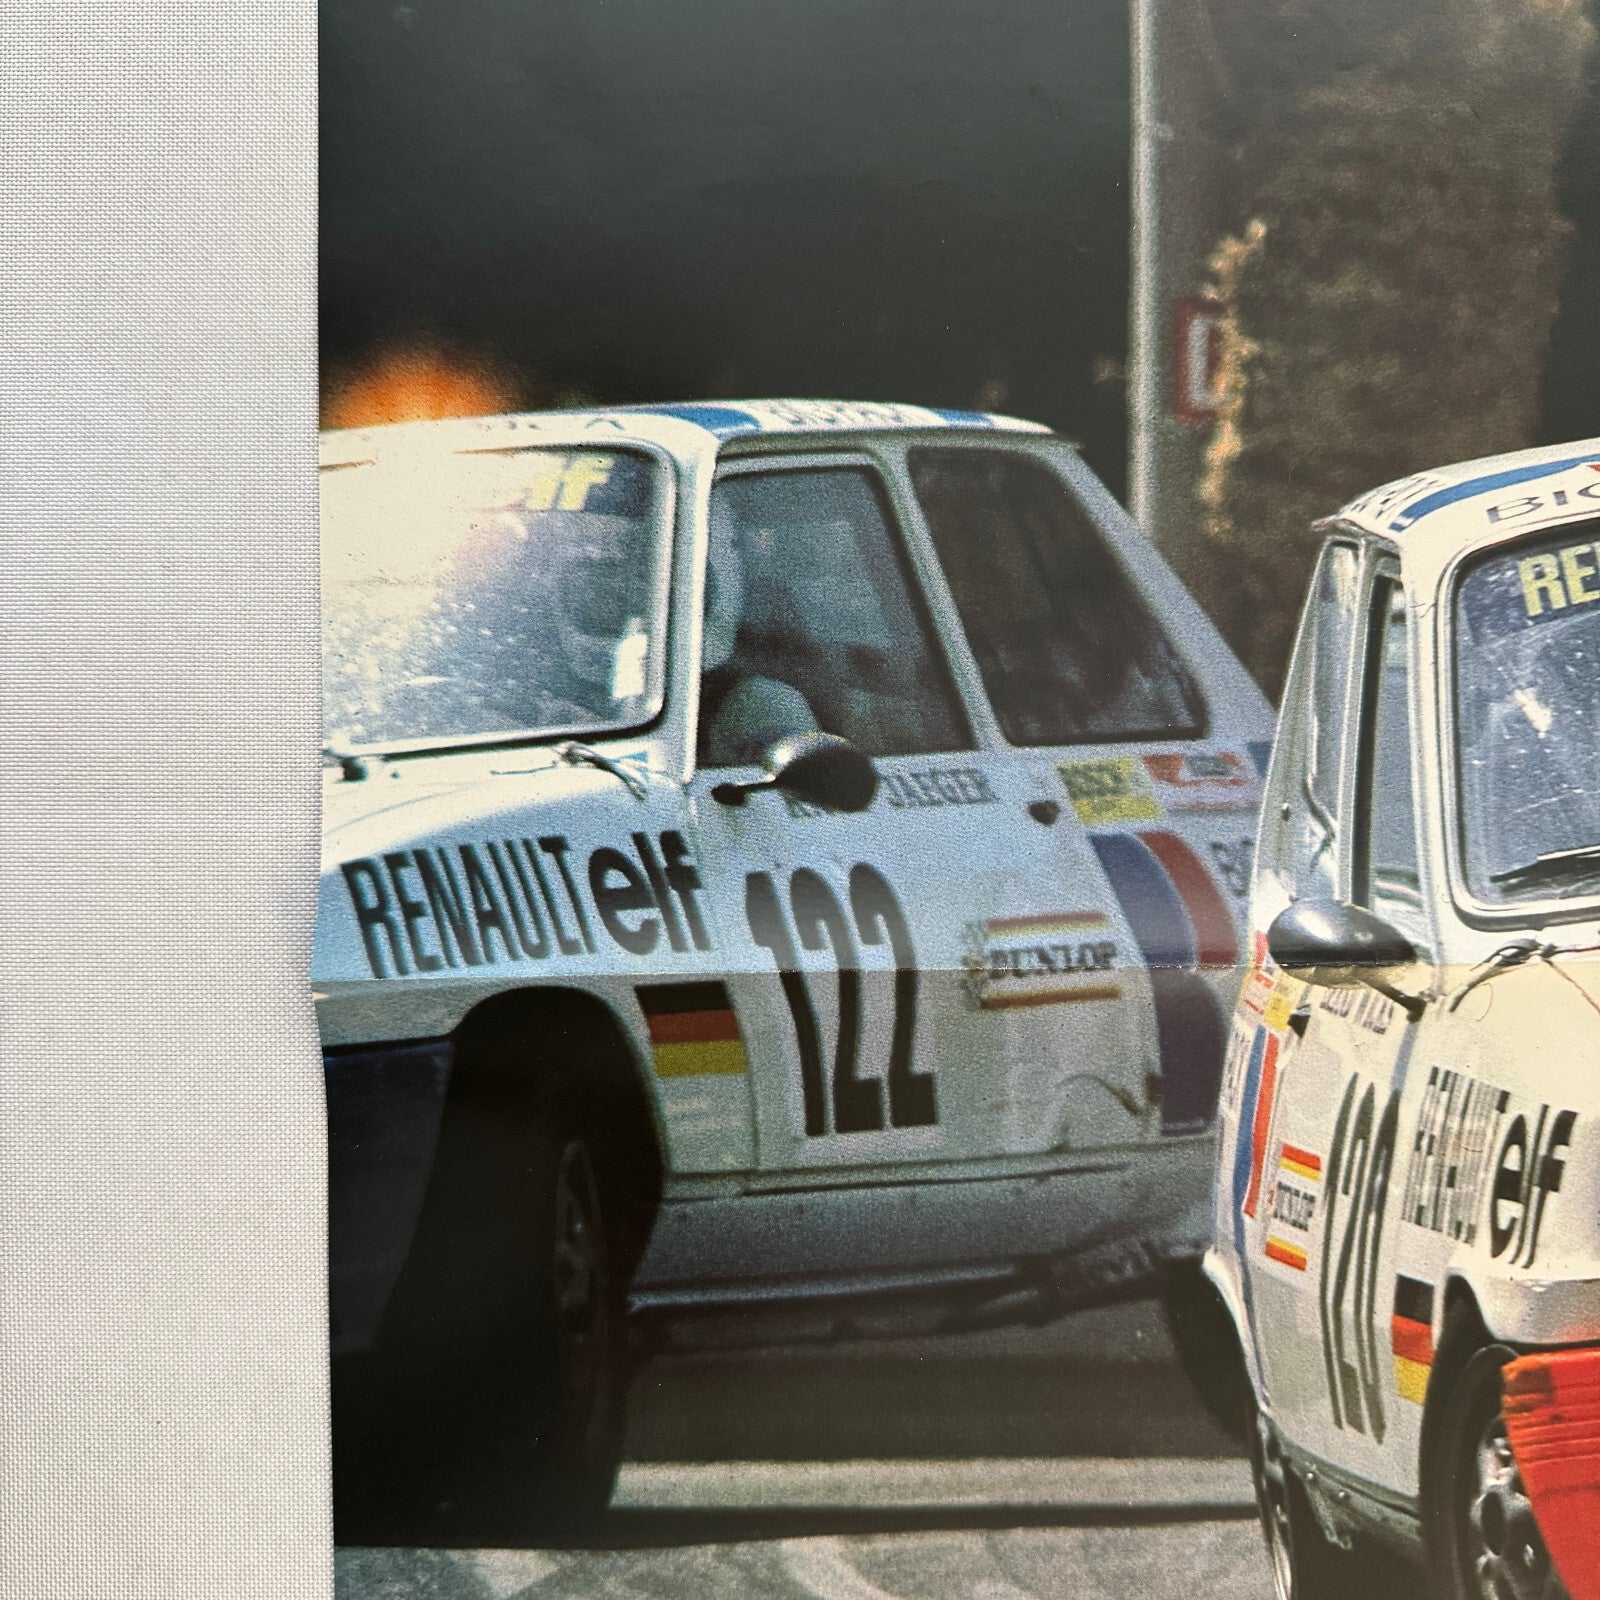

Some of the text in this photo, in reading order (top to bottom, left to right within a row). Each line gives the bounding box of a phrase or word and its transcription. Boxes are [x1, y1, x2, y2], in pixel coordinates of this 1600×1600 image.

[1518, 541, 1600, 617] RE
[340, 830, 713, 979] RENAULT elf
[989, 940, 1118, 981] DUNLOP
[745, 862, 939, 1137] 122
[1489, 1102, 1579, 1270] elf
